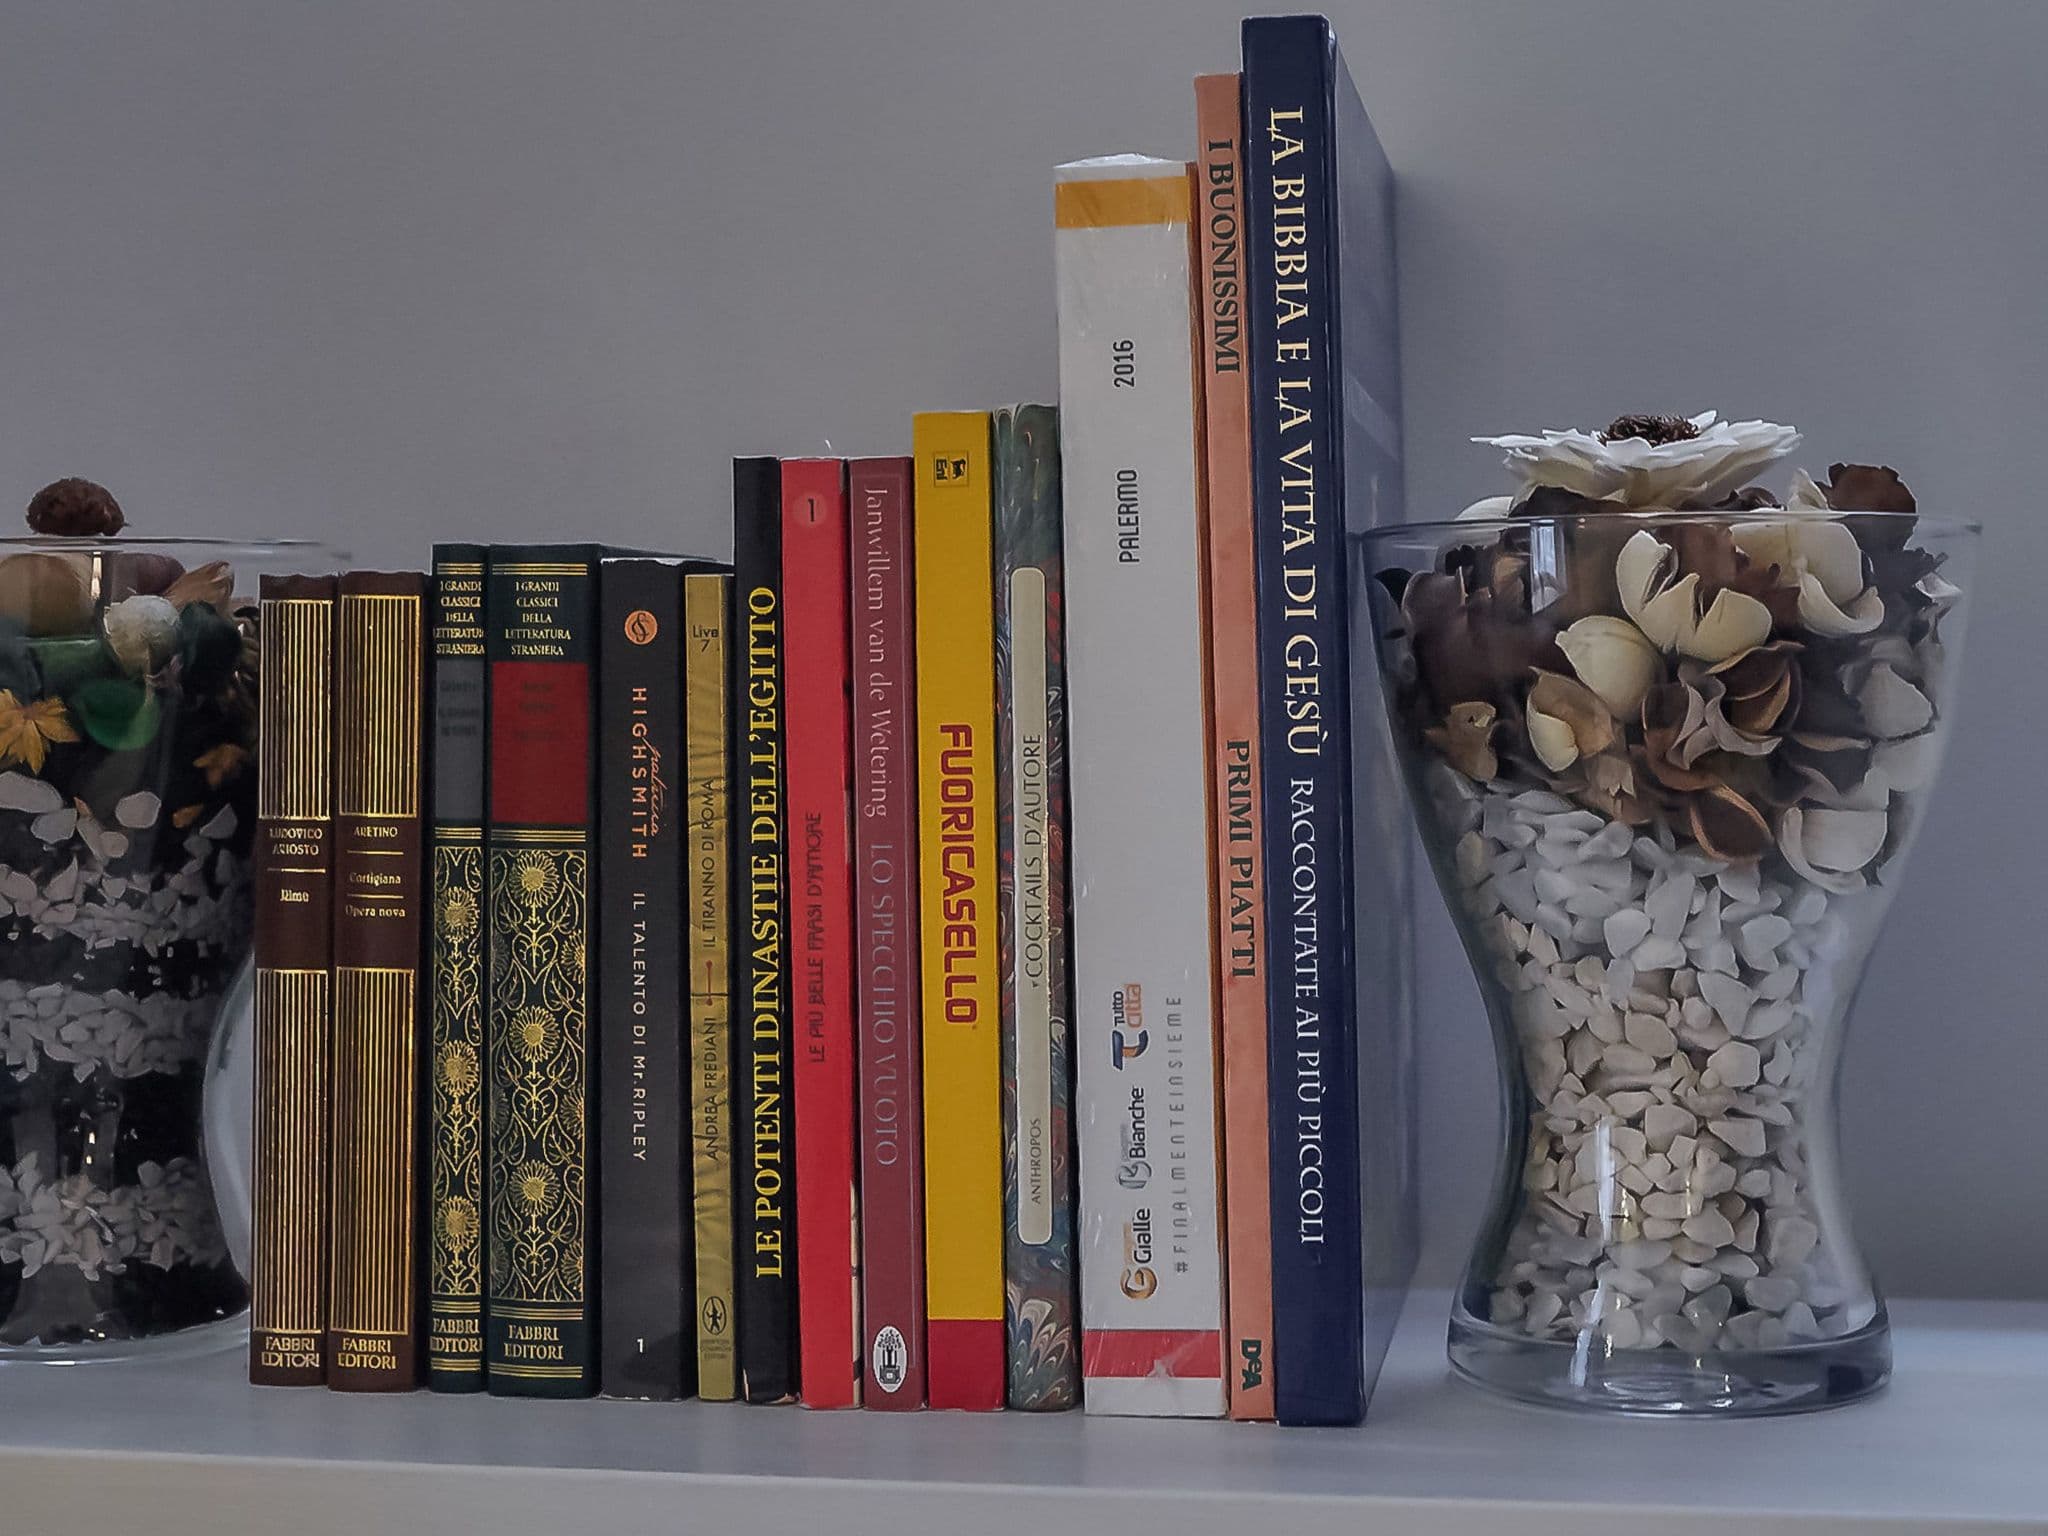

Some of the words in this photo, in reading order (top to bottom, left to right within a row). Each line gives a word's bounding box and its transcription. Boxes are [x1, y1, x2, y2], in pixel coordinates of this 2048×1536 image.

[1208, 138, 1233, 152] I
[1266, 107, 1304, 165] LA
[1209, 163, 1240, 374] BUONISSIMI
[1271, 173, 1310, 330] BIBBIA
[1113, 340, 1135, 388] 2016
[1276, 338, 1311, 364] E
[1274, 377, 1312, 434] LA
[808, 498, 814, 522] 1
[1117, 469, 1140, 563] PALERMO
[1279, 440, 1317, 556] VITA
[516, 597, 558, 607] CLASSICI
[521, 581, 559, 592] GRANDI
[1283, 565, 1318, 622] DI
[522, 613, 552, 623] DELLA
[693, 625, 718, 638] Live
[870, 619, 884, 663] van
[511, 645, 564, 656] STRANIERA
[700, 640, 710, 653] 7
[869, 672, 892, 701] de
[1284, 634, 1328, 756] GESÙ
[749, 587, 777, 843] DELL'EGITTO
[632, 687, 647, 858] HIGHSMITH
[863, 709, 891, 818] Wetering
[702, 778, 714, 827] ROMA
[1022, 735, 1042, 846] D'AUTORE
[1226, 740, 1252, 843] PRIMI
[270, 828, 323, 840] LUDOVICO
[272, 844, 319, 856] ARIOSTO
[354, 826, 398, 838] ARETINO
[702, 834, 714, 854] DI
[805, 813, 822, 896] D'AMORE
[870, 845, 895, 884] LO
[940, 724, 977, 1023] FUORICASELLO
[1290, 777, 1320, 999] RACCONTATE
[379, 907, 405, 917] nova
[633, 893, 646, 909] IL
[702, 858, 716, 930] TIRANNO
[1230, 856, 1256, 977] PIATTI
[703, 935, 716, 948] IL
[806, 905, 822, 949] FRASI
[1024, 857, 1043, 980] COCKTAILS
[633, 921, 646, 1015] TALENTO
[751, 854, 779, 1041] DINASTIE
[871, 894, 896, 1044] SPECCHIO
[808, 957, 825, 1004] BELLE
[633, 1025, 646, 1045] DI
[1296, 1005, 1320, 1040] AI
[705, 1017, 717, 1088] FREDIANI
[810, 1045, 825, 1063] LE
[1297, 1050, 1327, 1104] PIÙ
[705, 1096, 718, 1160] ANDREA
[874, 1053, 898, 1166] VUOTO
[1129, 1086, 1146, 1158] Bianche
[754, 1051, 781, 1220] POTENTI
[1030, 1118, 1041, 1205] ANTHROPOS
[1298, 1113, 1324, 1244] PICCOLI
[755, 1230, 783, 1279] LE
[1133, 1207, 1151, 1264] Gialle
[266, 1337, 315, 1351] FABBRI
[343, 1337, 391, 1353] FABBRI
[433, 1318, 479, 1334] FABBRI
[508, 1324, 559, 1340] FABBRI
[636, 1338, 644, 1353] 1
[261, 1352, 320, 1367] EDITORI
[338, 1352, 397, 1369] EDITORI
[504, 1343, 564, 1360] EDITORI
